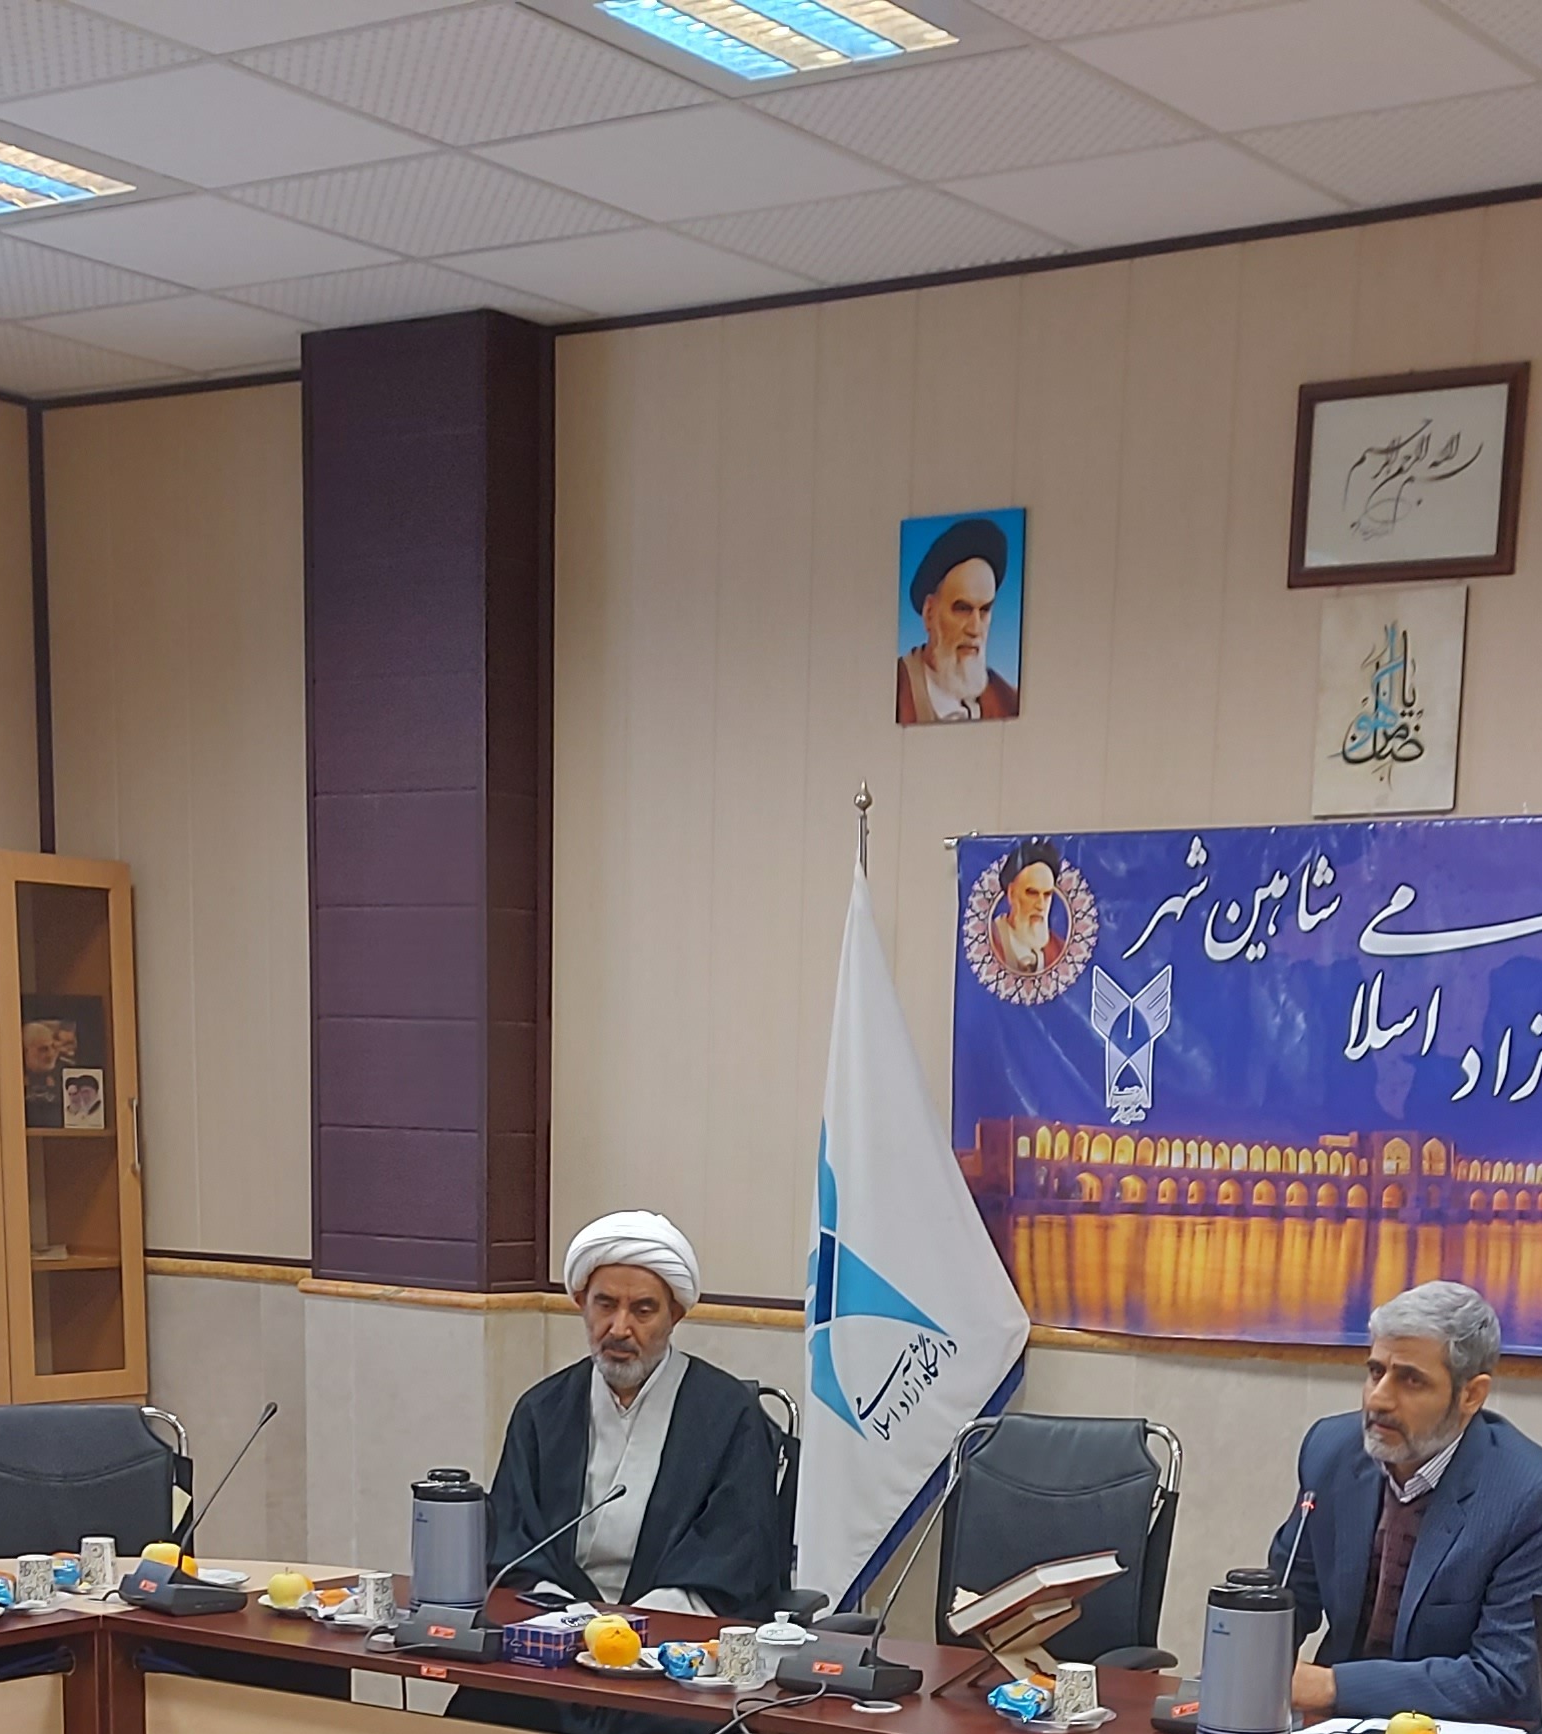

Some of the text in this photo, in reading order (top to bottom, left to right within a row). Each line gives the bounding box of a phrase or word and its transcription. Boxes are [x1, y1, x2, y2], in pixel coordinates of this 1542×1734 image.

[1122, 835, 1209, 960] شهر
[1204, 855, 1342, 962] شاهین
[908, 1332, 958, 1386] دانشگاه
